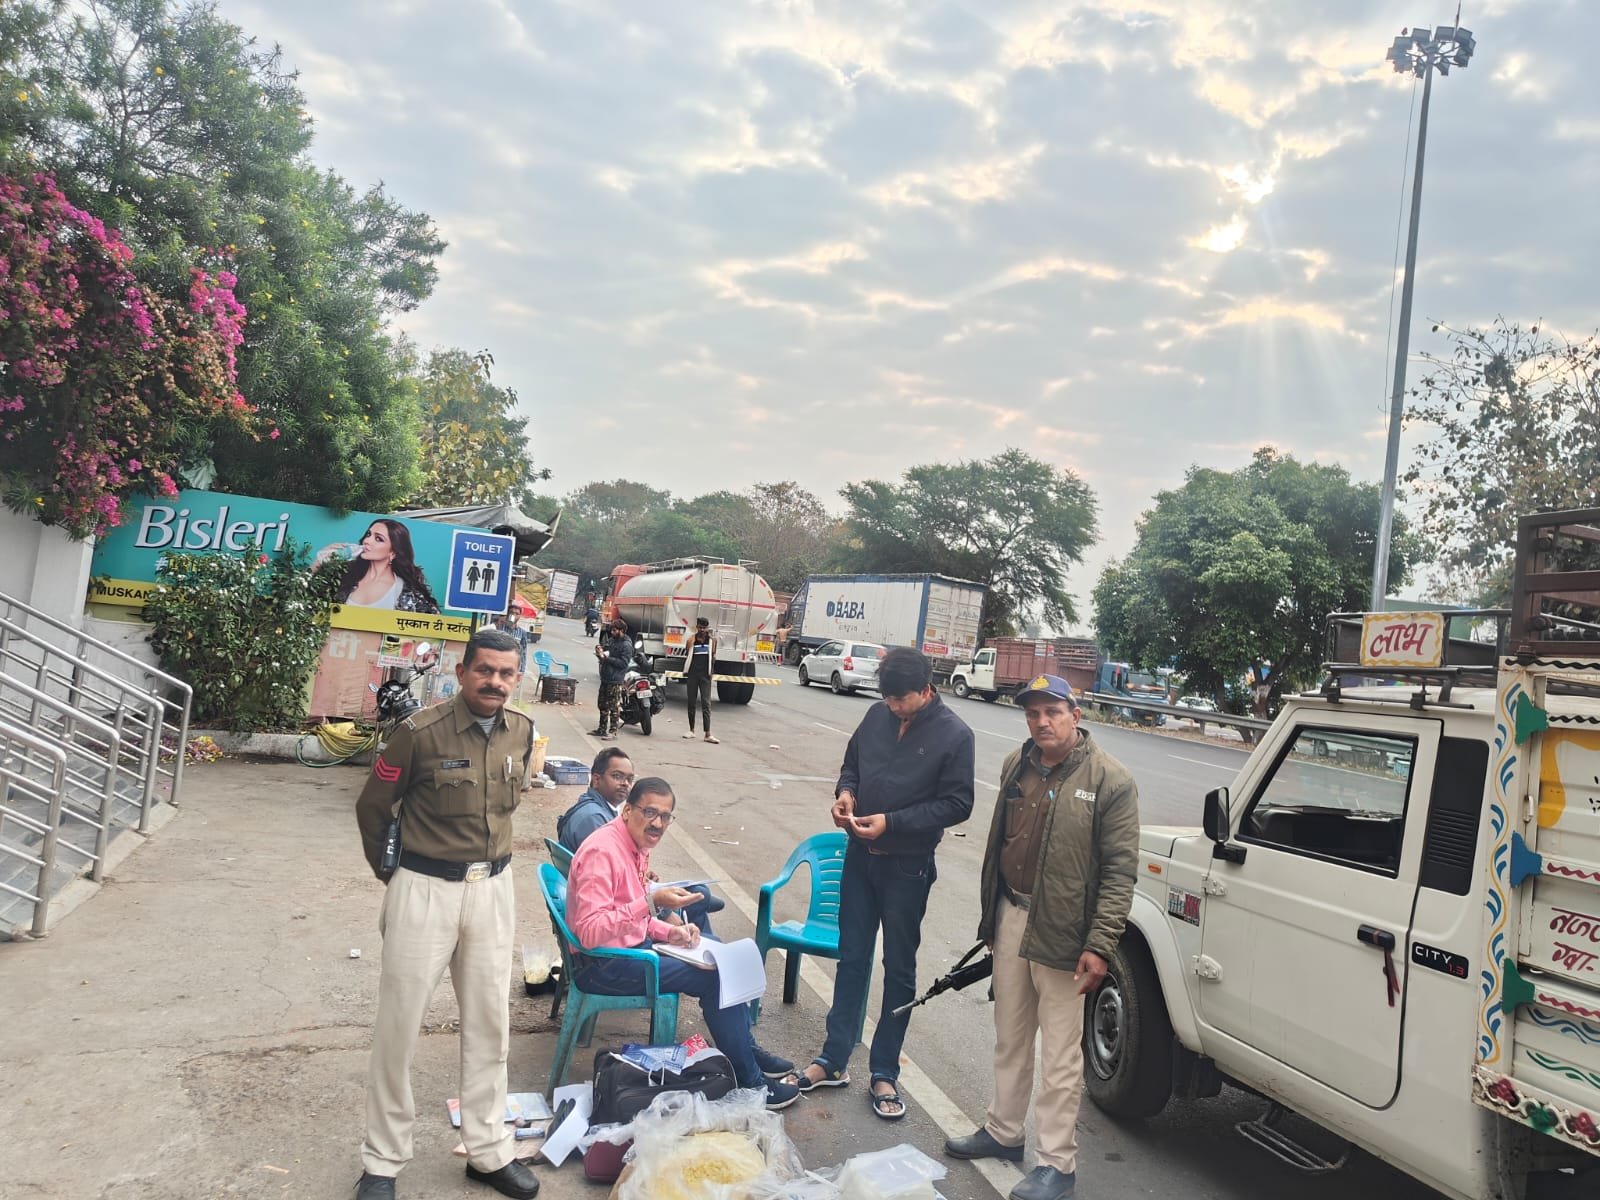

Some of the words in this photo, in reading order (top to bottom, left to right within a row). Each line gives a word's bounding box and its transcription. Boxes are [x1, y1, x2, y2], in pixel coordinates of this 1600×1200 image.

[134, 505, 290, 551] Bisleri
[464, 541, 503, 554] TOILET
[834, 601, 865, 620] BABA
[396, 618, 429, 631] मुस्कान
[433, 619, 443, 631] टी
[1370, 623, 1434, 657] लाभ
[1415, 945, 1452, 964] CITY
